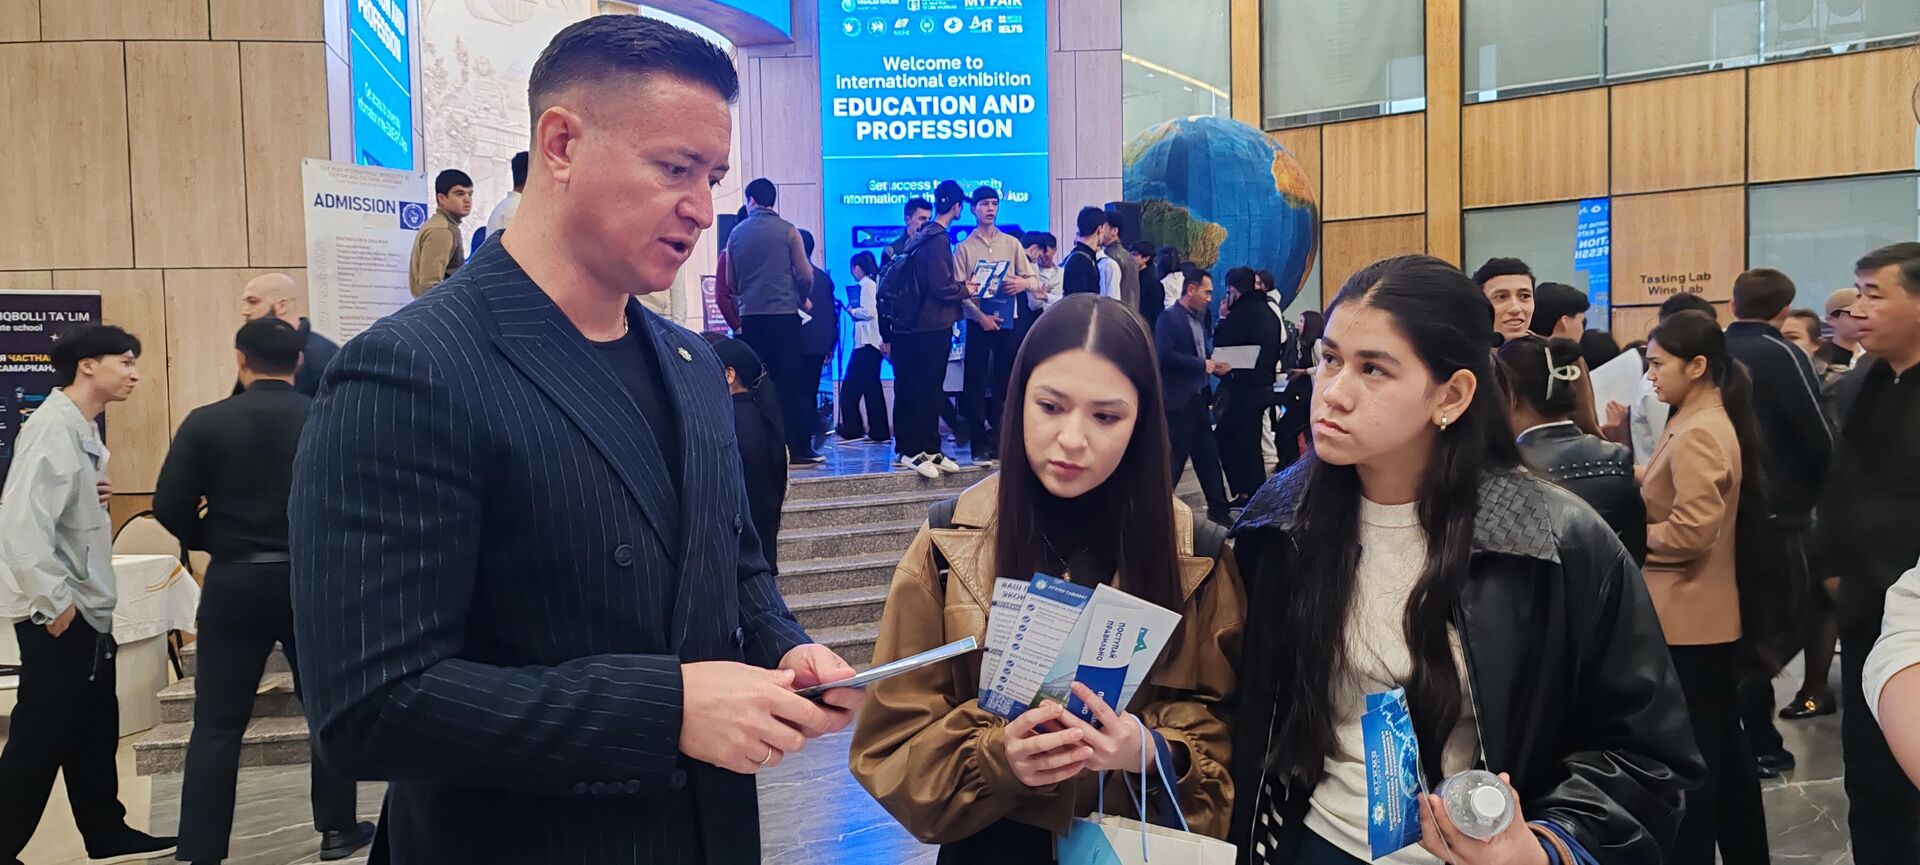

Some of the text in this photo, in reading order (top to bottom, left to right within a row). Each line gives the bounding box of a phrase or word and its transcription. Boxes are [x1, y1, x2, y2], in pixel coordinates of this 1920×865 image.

[882, 56, 984, 72] Welcome to
[836, 72, 1031, 90] international exhibition
[833, 94, 1036, 118] EDUCATION AND
[856, 118, 1013, 141] PROFESSION
[314, 192, 396, 215] ADMISSION
[1640, 271, 1711, 284] Tasting Lab
[1648, 285, 1677, 295] Wine
[13, 323, 43, 332] school
[8, 354, 51, 362] ЧАСТНА
[1096, 620, 1114, 661] ПРАВИЛЬНО
[1109, 622, 1127, 659] ПОСТУПАЙ
